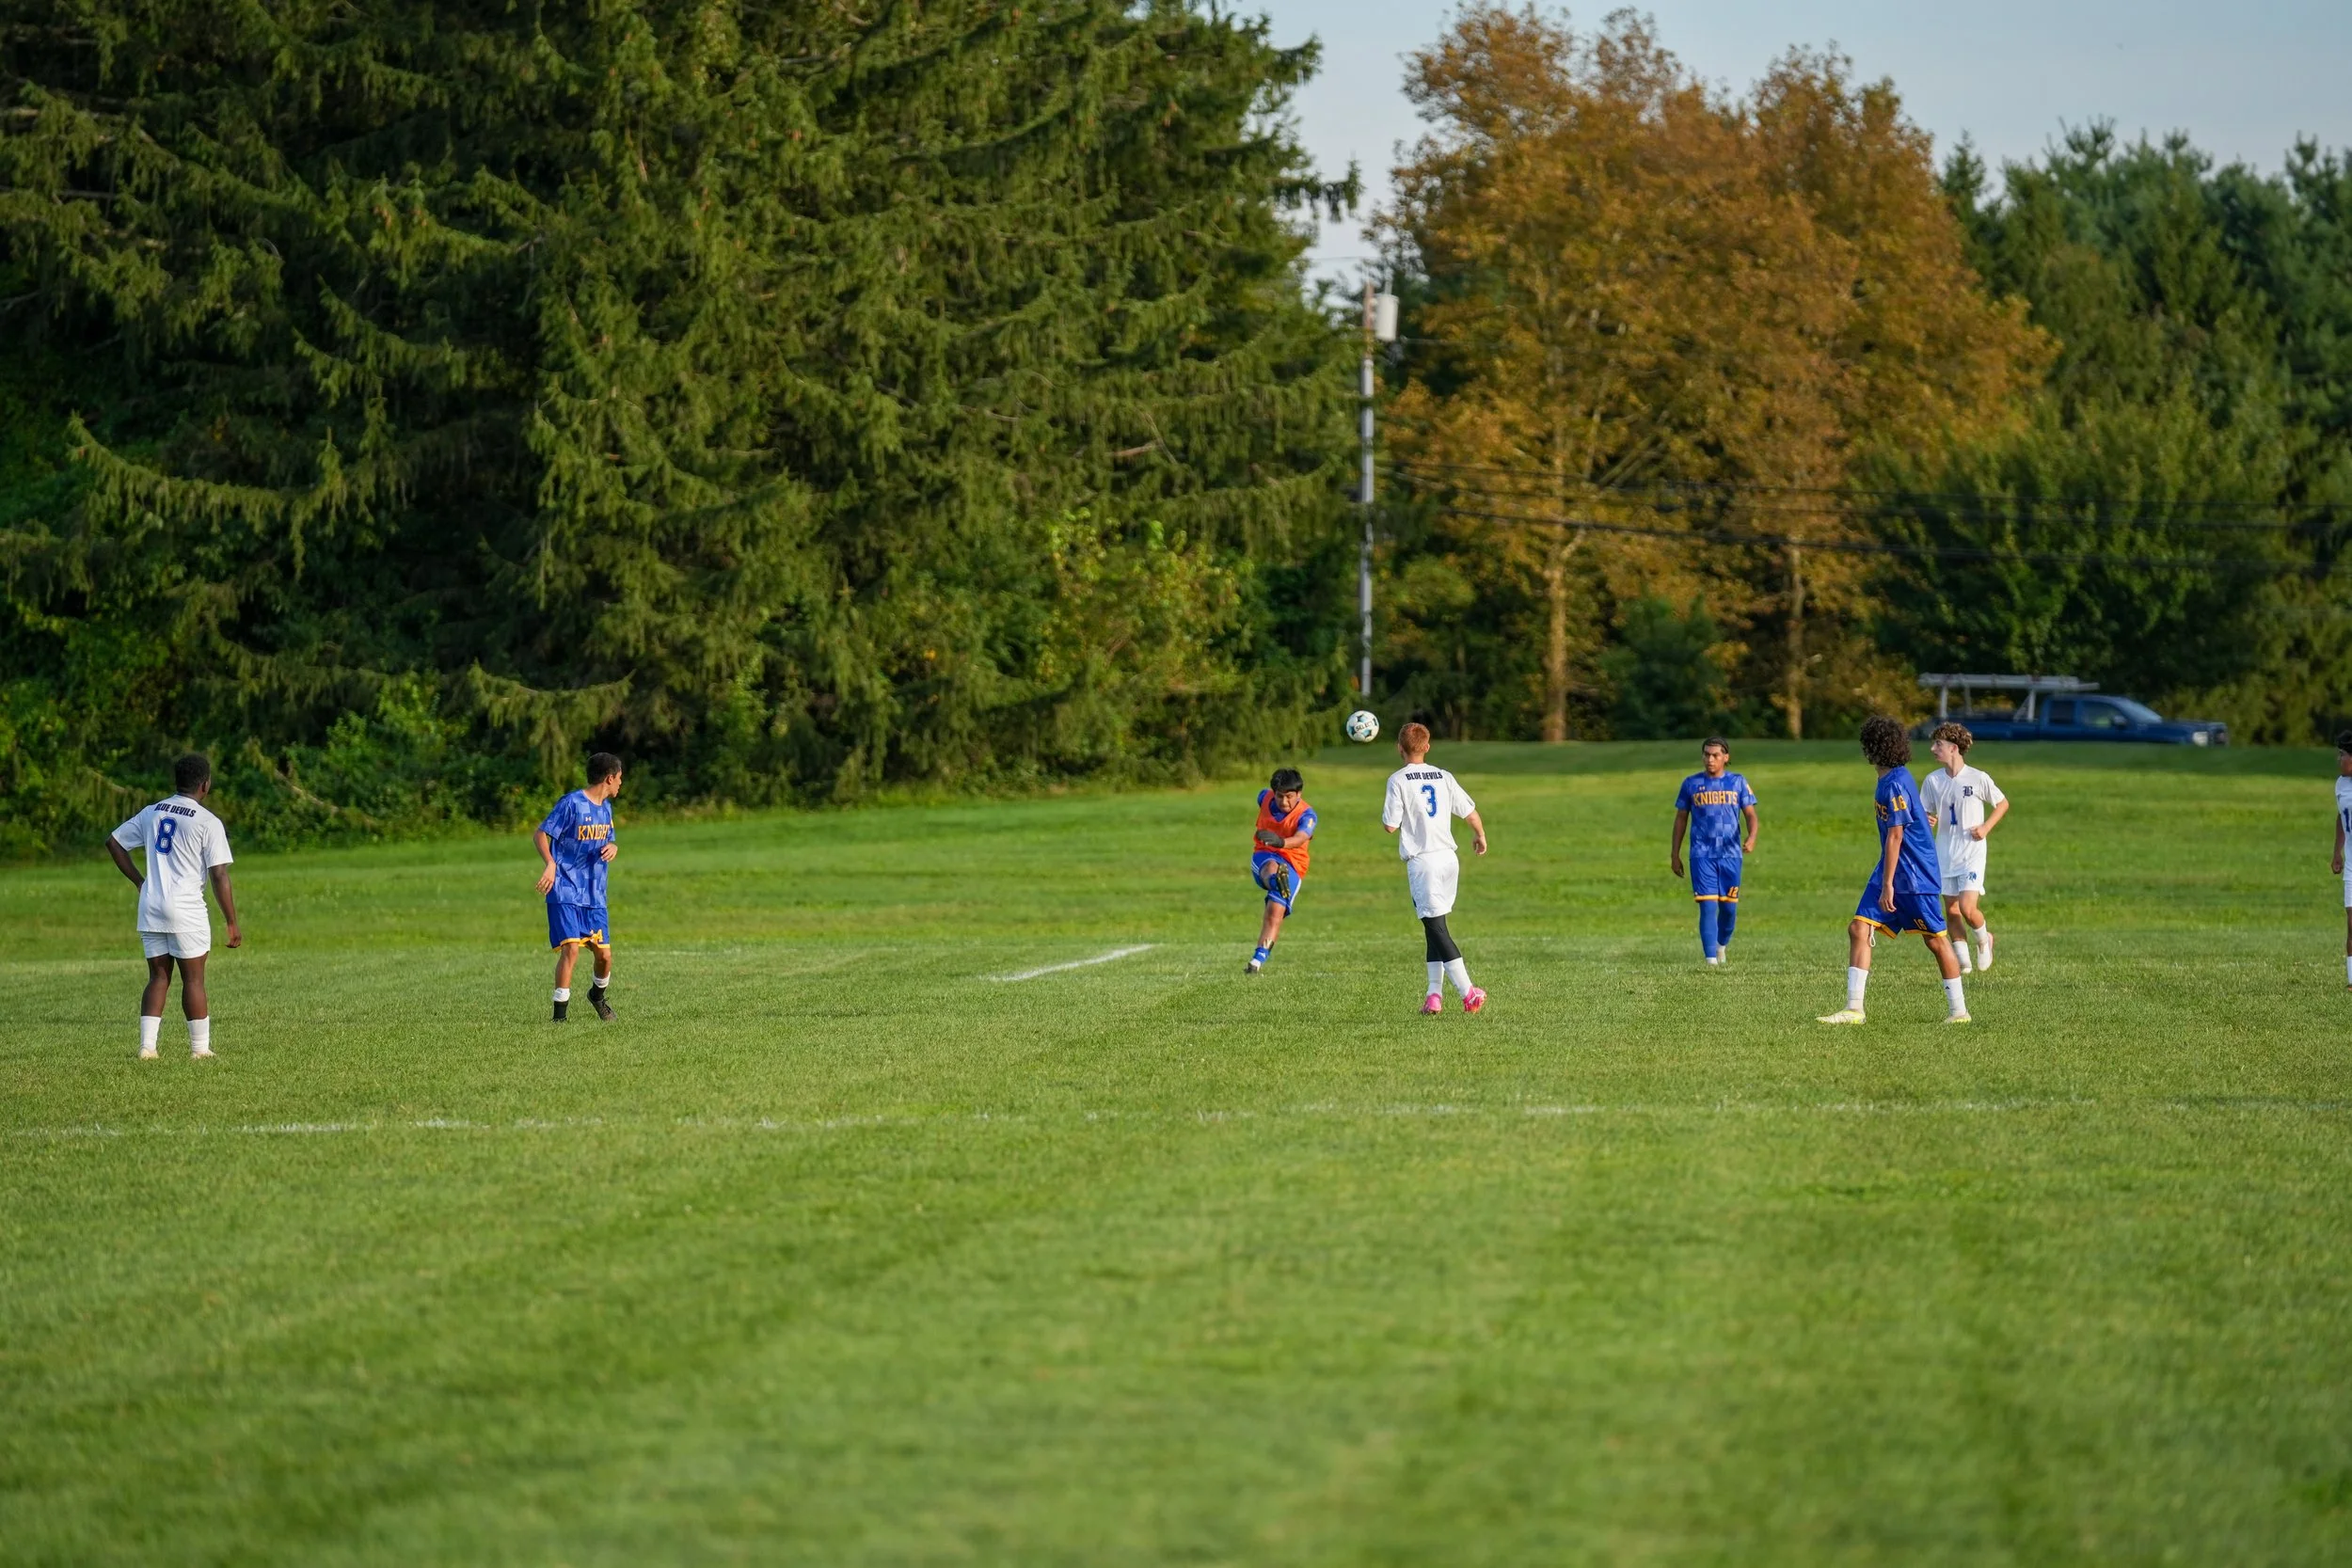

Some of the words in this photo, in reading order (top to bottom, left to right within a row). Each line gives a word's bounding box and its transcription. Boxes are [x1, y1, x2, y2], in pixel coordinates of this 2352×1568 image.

[1406, 772, 1422, 781] BLUE
[1422, 772, 1443, 781] DEVILS
[1421, 784, 1438, 817] 3
[1692, 790, 1739, 806] KNIGHTS
[1891, 795, 1907, 812] 16
[154, 802, 169, 813] BLUE
[170, 804, 197, 817] DEVILS
[1949, 803, 1958, 826] 1
[155, 816, 177, 855] 8
[1727, 886, 1739, 897] 12
[1914, 918, 1928, 930] 16
